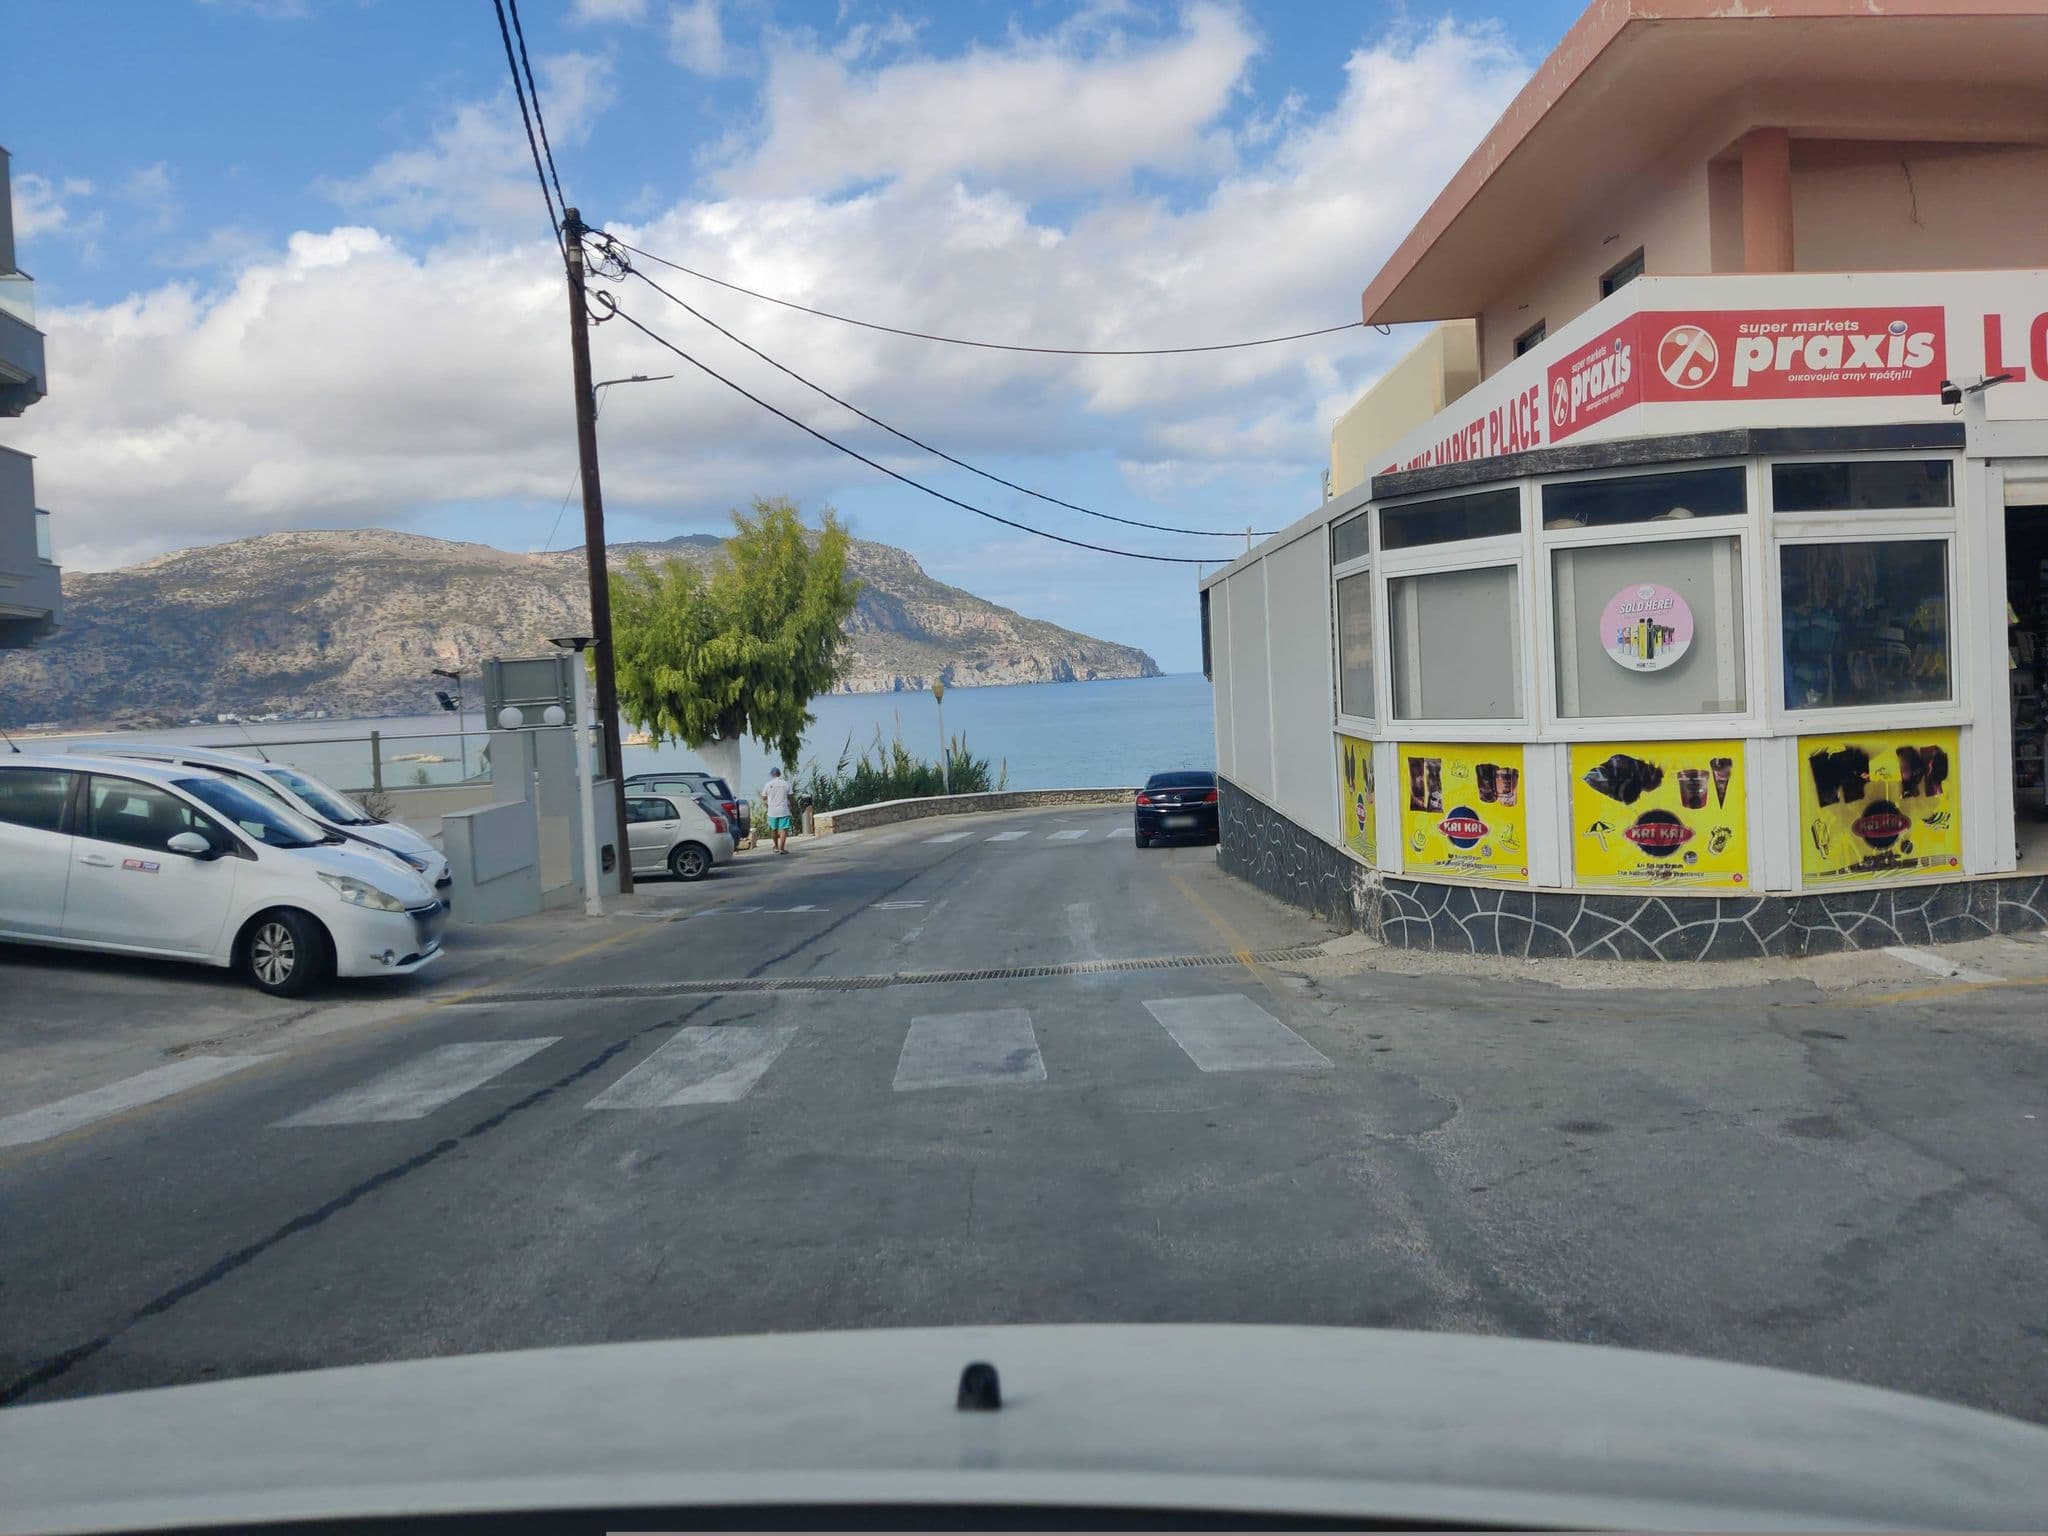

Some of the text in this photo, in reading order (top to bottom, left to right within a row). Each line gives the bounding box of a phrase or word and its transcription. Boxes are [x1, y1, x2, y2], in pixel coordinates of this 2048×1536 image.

[1739, 320, 1859, 335] super markets
[1732, 320, 1935, 387] praxis
[1570, 338, 1631, 423] praxis
[1788, 371, 1839, 383] οικονομία
[1842, 372, 1866, 381] στην
[1435, 417, 1485, 465] MARKET
[1490, 384, 1540, 456] PLACE
[1620, 598, 1674, 614] SOLD HERE!
[1443, 822, 1482, 833] KRI KRI
[1631, 828, 1684, 839] KRI KRI
